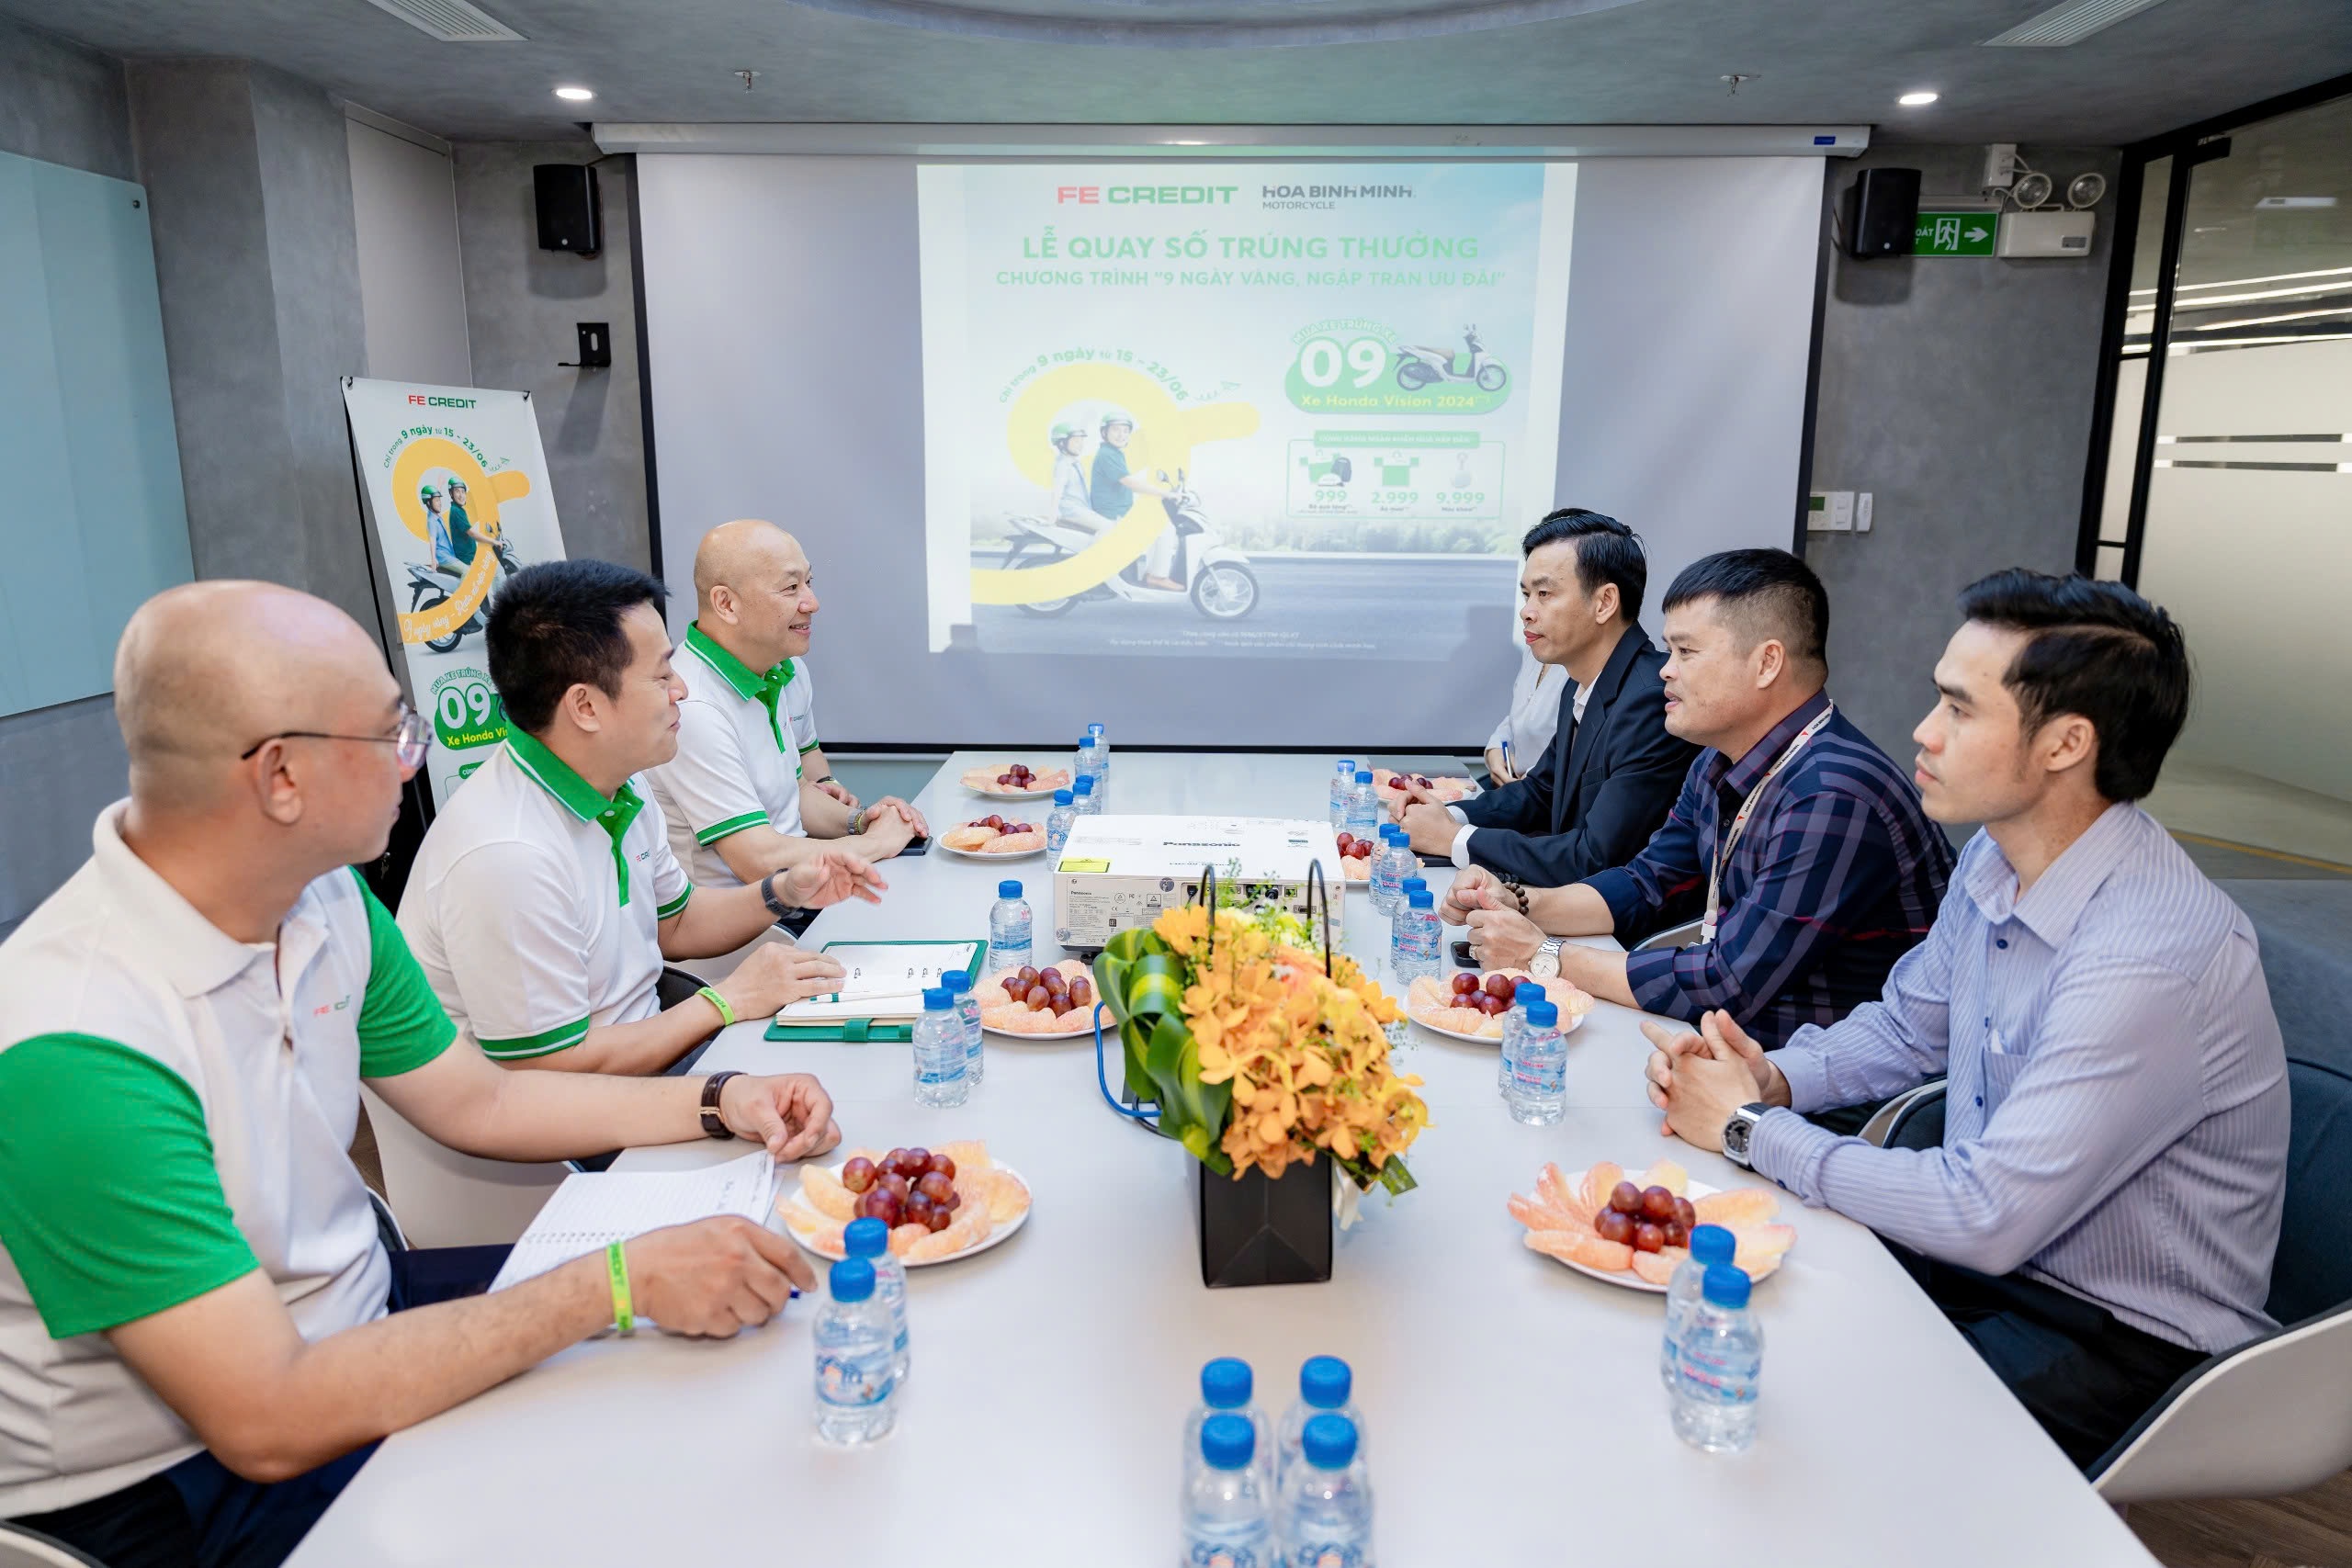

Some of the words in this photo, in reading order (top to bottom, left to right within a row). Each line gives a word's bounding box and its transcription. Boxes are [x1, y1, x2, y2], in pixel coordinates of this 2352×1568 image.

[1057, 186, 1100, 204] FE
[1108, 186, 1238, 204] CREDIT
[1262, 201, 1335, 210] MOTORCYCLE
[1023, 225, 1058, 258] LỄ
[1068, 237, 1155, 259] QUAY
[1165, 229, 1209, 258] SỐ
[1218, 231, 1328, 259] TRÚNG
[1338, 230, 1478, 259] THƯỞNG
[996, 270, 1083, 286] CHƯƠNG
[1090, 268, 1148, 286] TRÌNH
[1181, 268, 1234, 286] NGÀY
[1300, 338, 1386, 389] 09
[1037, 354, 1049, 367] 9
[1053, 346, 1095, 362] ngày
[1116, 349, 1134, 363] 15
[1146, 361, 1189, 400] 23/06
[408, 395, 425, 405] FE
[428, 397, 477, 409] CREDIT
[1301, 395, 1320, 406] Xe
[1326, 395, 1378, 407] Honda
[1384, 395, 1431, 407] Vision
[1436, 396, 1476, 407] 2024
[401, 430, 408, 439] 9
[410, 424, 433, 435] ngày
[444, 427, 454, 437] 15
[462, 437, 488, 468] 23/06
[1315, 490, 1348, 502] 999
[1371, 491, 1419, 504] 2.999
[1436, 491, 1485, 504] 9.999
[430, 676, 445, 694] MUA
[445, 671, 457, 682] XE
[456, 667, 482, 678] TRÚNG
[439, 684, 491, 729] 09
[447, 736, 460, 747] Xe
[462, 729, 494, 744] Honda
